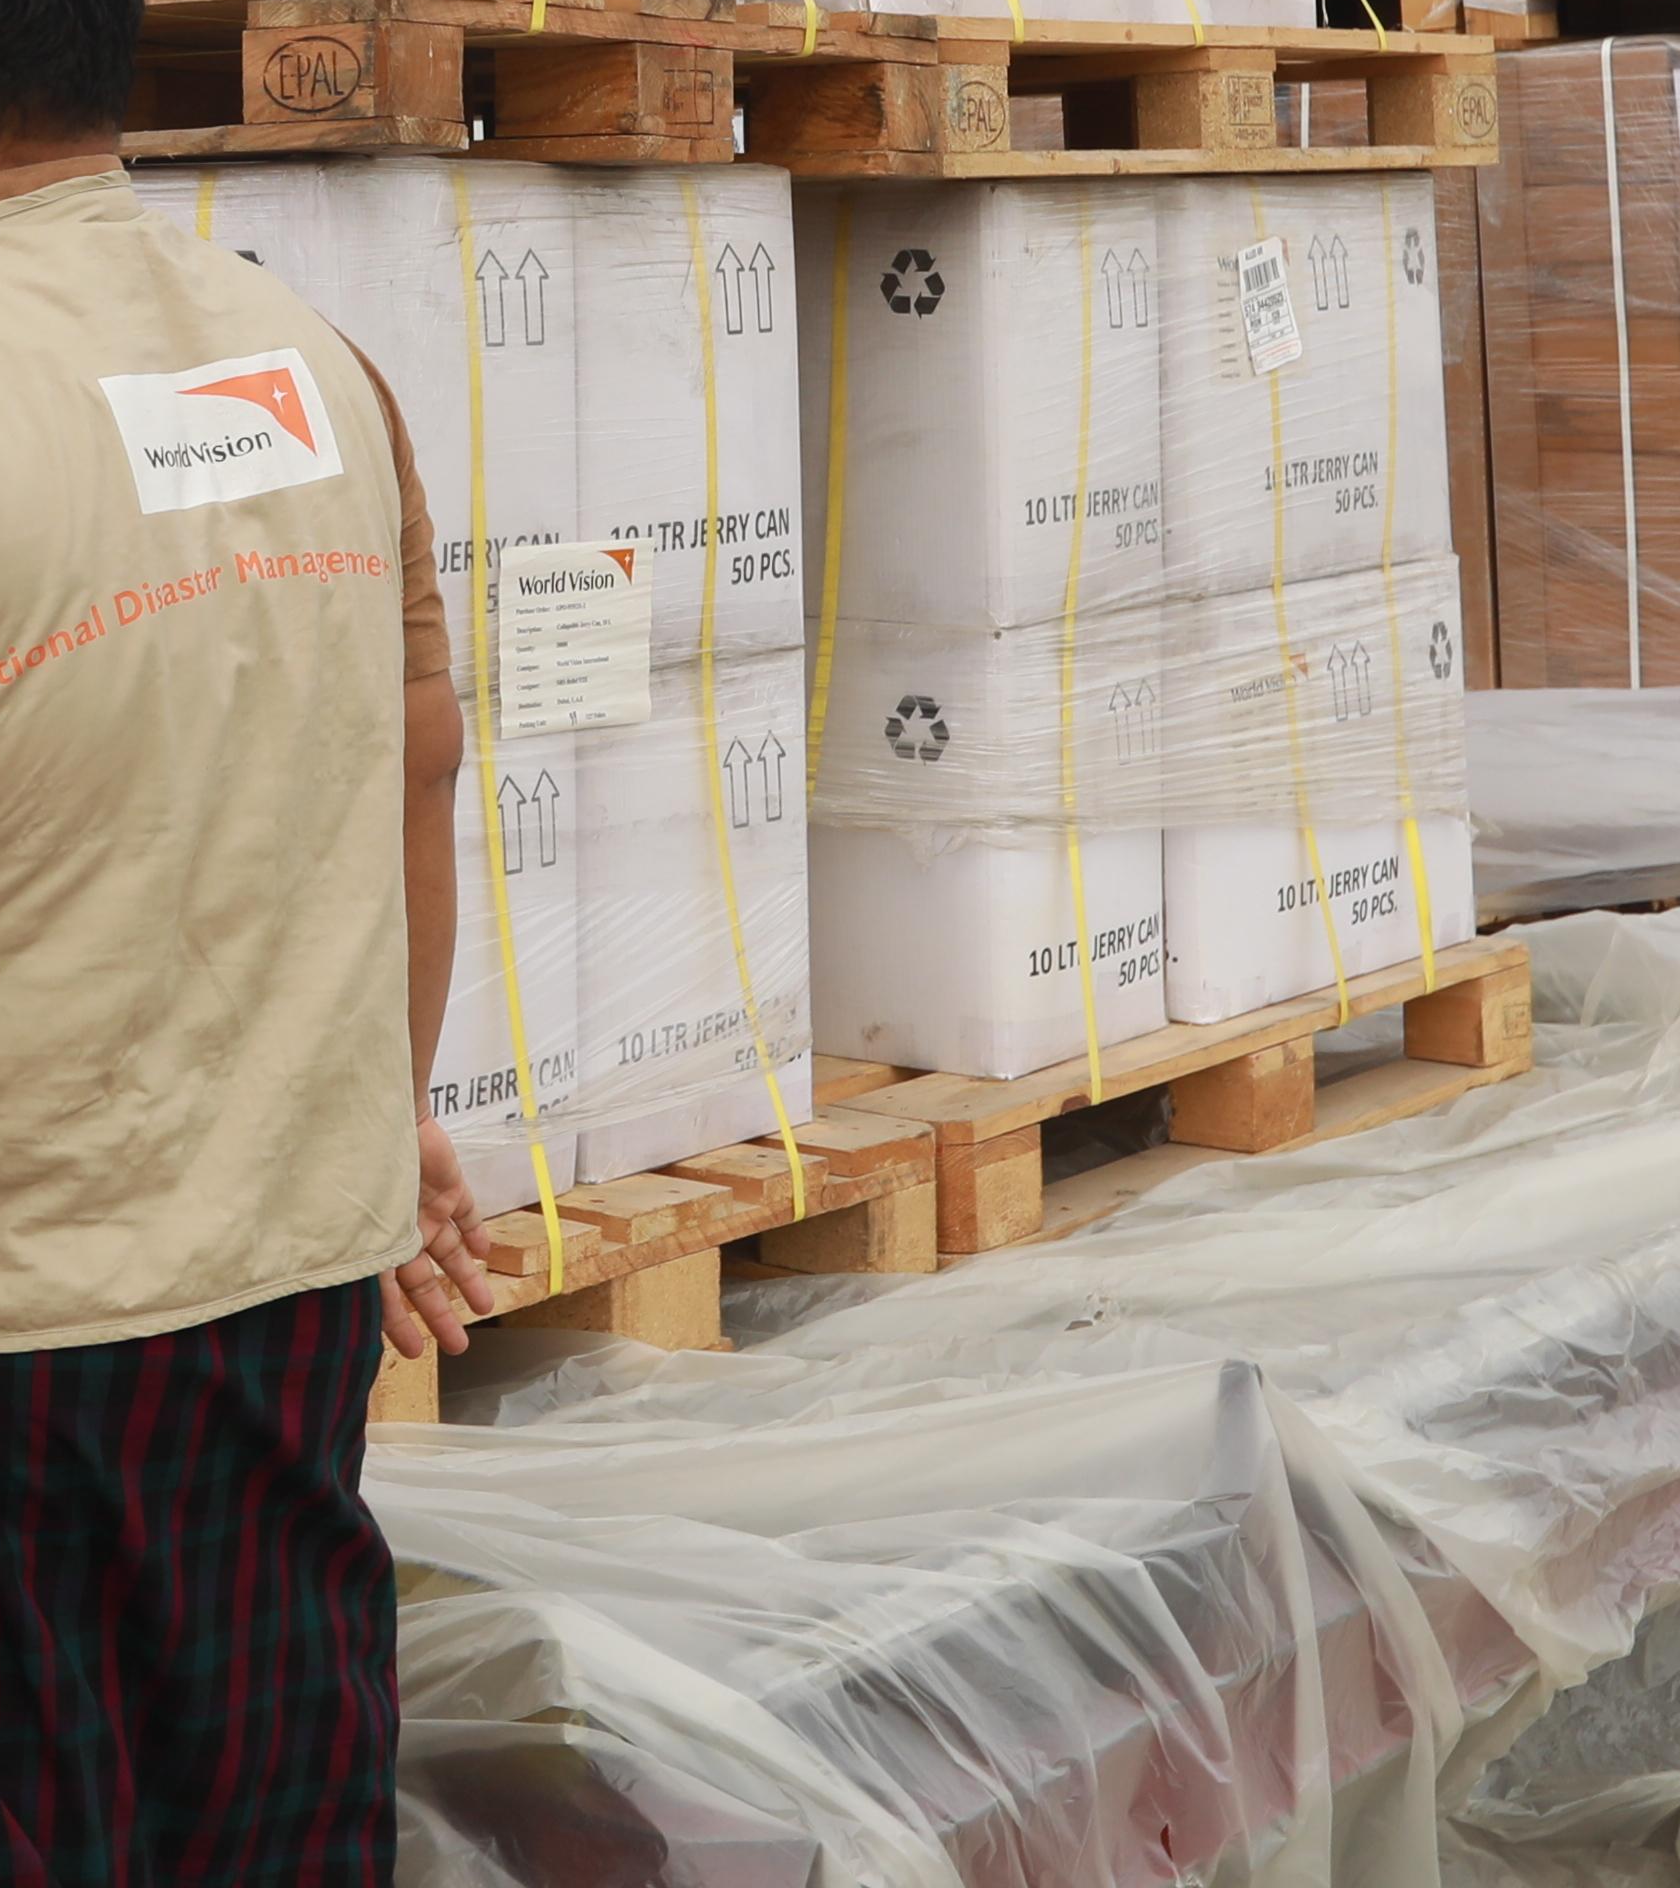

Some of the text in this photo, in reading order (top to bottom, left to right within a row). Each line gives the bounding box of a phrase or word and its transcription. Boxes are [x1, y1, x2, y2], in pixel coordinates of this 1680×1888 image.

[278, 52, 348, 99] EPAL
[957, 97, 998, 133] EPAL
[1461, 96, 1491, 126] EPAL
[143, 427, 273, 471] World Vision
[1283, 450, 1379, 489] LTR JERRY CAN
[1024, 498, 1048, 528] 10
[1086, 485, 1130, 519] JERRY
[1133, 481, 1160, 511] CAN
[1334, 485, 1379, 514] 50 PCS.
[518, 569, 615, 596] World Vision
[730, 549, 795, 586] 50 PCS.
[113, 564, 222, 627] Disaster
[1276, 885, 1295, 914] 10
[1328, 864, 1369, 900] JERRY
[1371, 855, 1400, 888] CAN
[1351, 888, 1399, 926] 50 PCS.
[1028, 949, 1053, 979] 10
[1091, 924, 1134, 964] JERRY
[1136, 913, 1160, 949] CAN
[618, 1021, 688, 1067] 10 LTR
